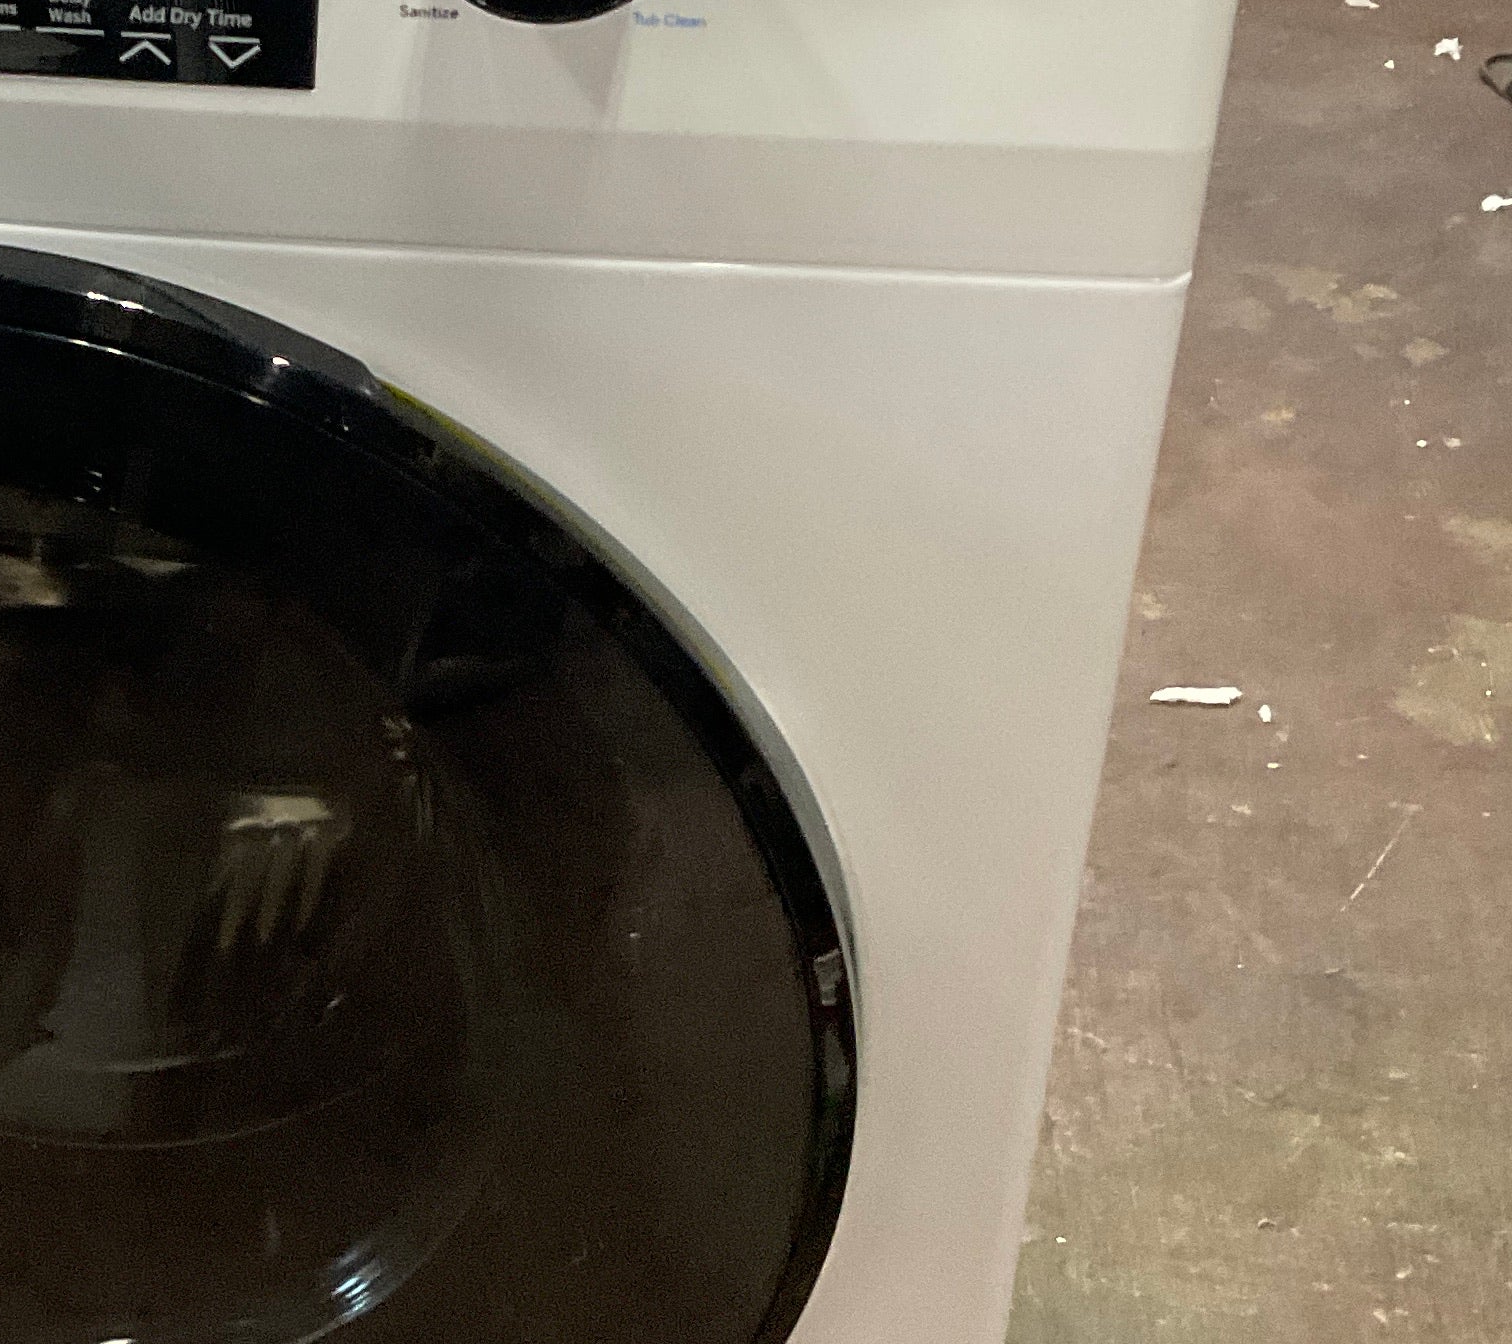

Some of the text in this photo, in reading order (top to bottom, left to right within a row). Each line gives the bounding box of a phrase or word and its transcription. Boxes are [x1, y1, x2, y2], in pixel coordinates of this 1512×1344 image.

[48, 7, 92, 25] Wash
[128, 6, 252, 29] Add Dry Time
[399, 4, 460, 19] Sanitize
